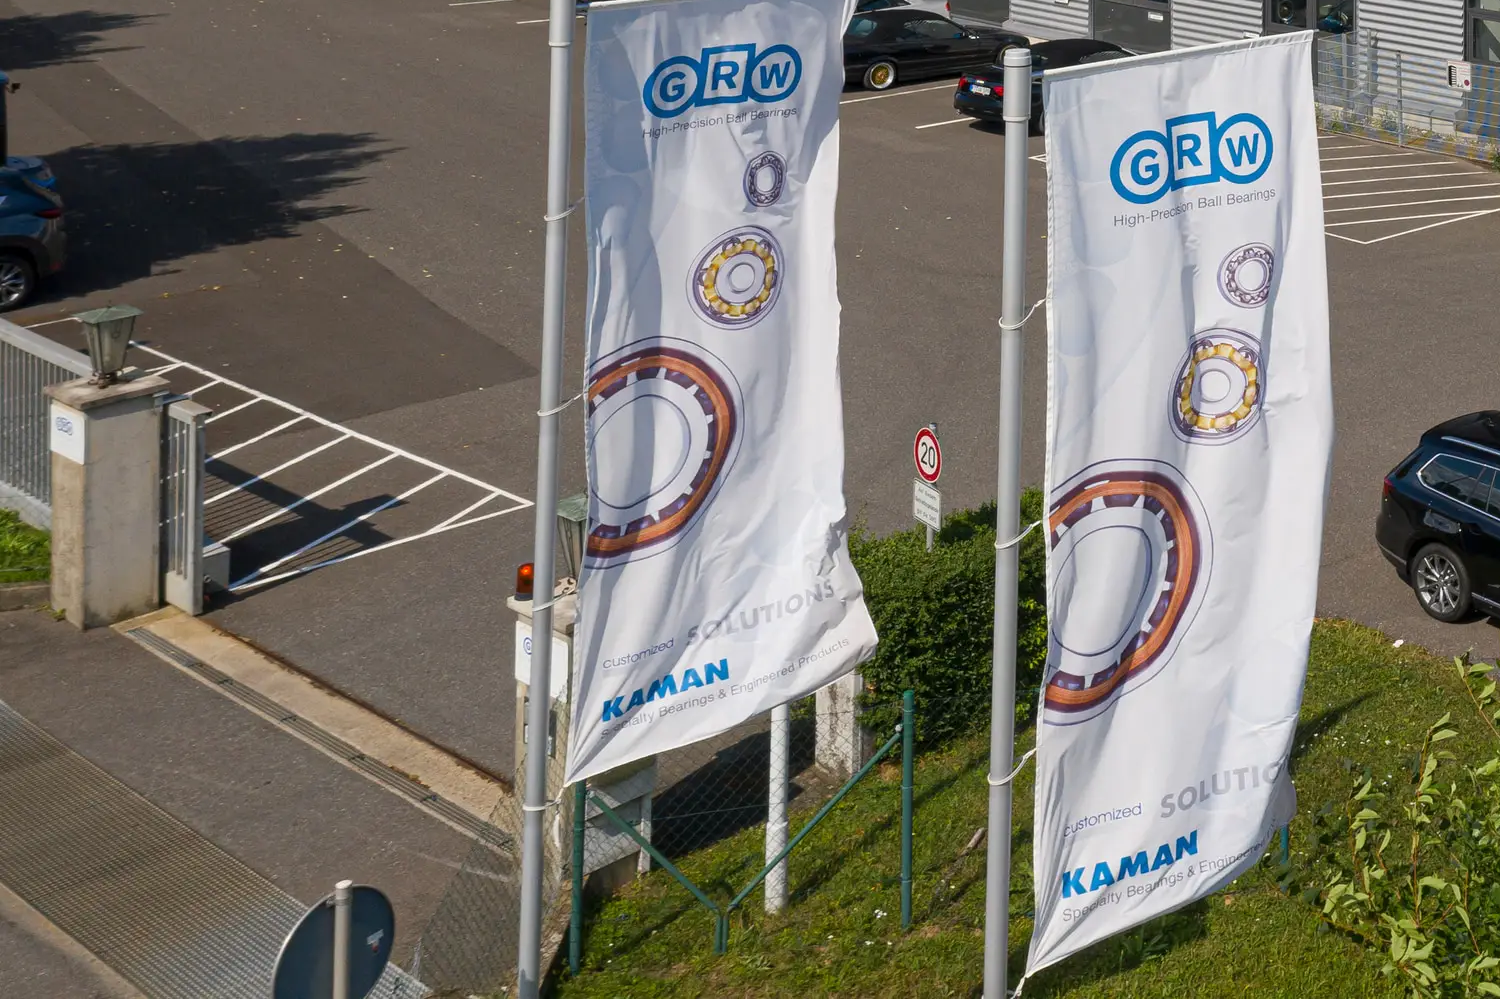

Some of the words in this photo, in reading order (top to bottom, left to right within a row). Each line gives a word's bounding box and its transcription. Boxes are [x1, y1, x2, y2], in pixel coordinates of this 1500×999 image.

[642, 115, 724, 139] High-Precision
[726, 112, 748, 124] Ball
[750, 107, 797, 121] Bearings
[1113, 200, 1194, 228] High-Precision
[1198, 194, 1222, 209] Ball
[1226, 186, 1277, 206] Bearings
[920, 441, 936, 469] 20
[602, 637, 674, 669] customized
[686, 578, 834, 647] SOLUTIONS
[600, 711, 655, 740] Secialty
[659, 692, 715, 718] Bearings
[718, 687, 728, 700] &
[730, 662, 796, 697] Engineered
[797, 637, 850, 669] Products
[601, 658, 729, 722] KAMAN
[1063, 802, 1142, 838] customized
[1160, 760, 1280, 819] SOLUTIO
[1061, 829, 1199, 899] KAMAN
[1062, 889, 1122, 923] Specialty
[1126, 872, 1184, 898] Bearings
[1187, 865, 1196, 878] &
